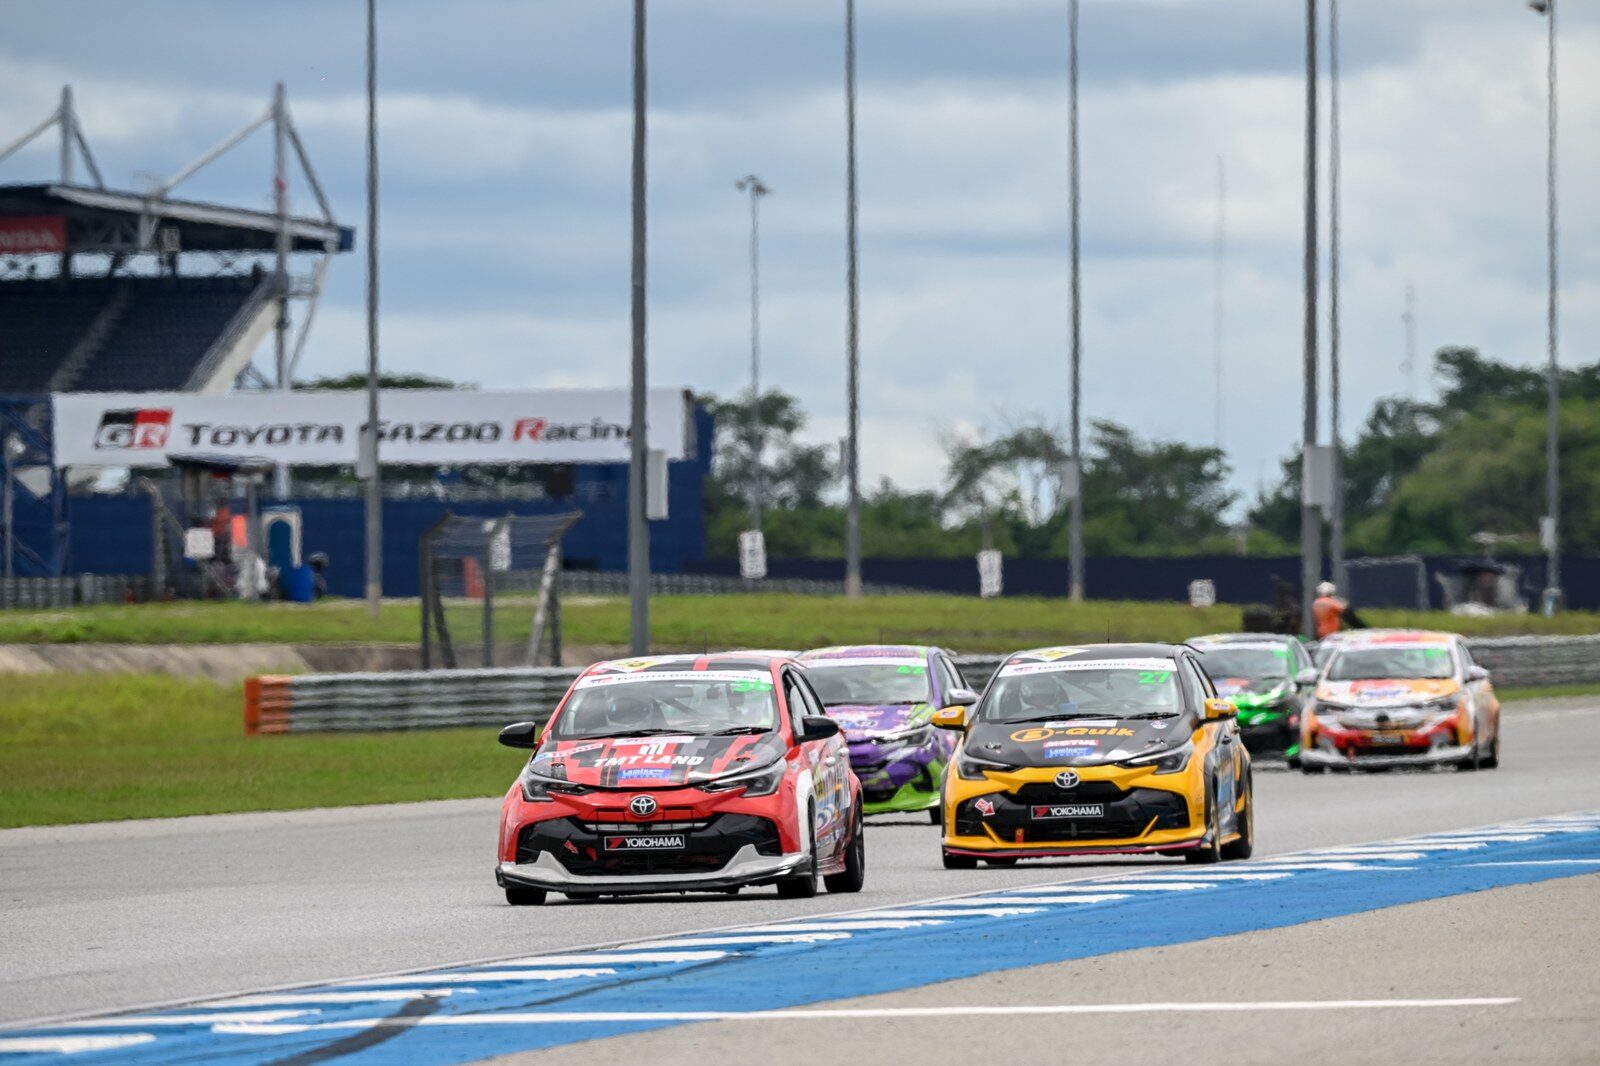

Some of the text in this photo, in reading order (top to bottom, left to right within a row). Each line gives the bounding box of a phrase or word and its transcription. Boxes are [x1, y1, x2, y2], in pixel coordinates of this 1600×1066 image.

[184, 423, 344, 446] TOYOTA
[1138, 671, 1171, 685] 27
[594, 755, 704, 767] TMT LAND
[1050, 806, 1102, 816] YOKOHAMA
[625, 837, 682, 848] YOKOHAMA
